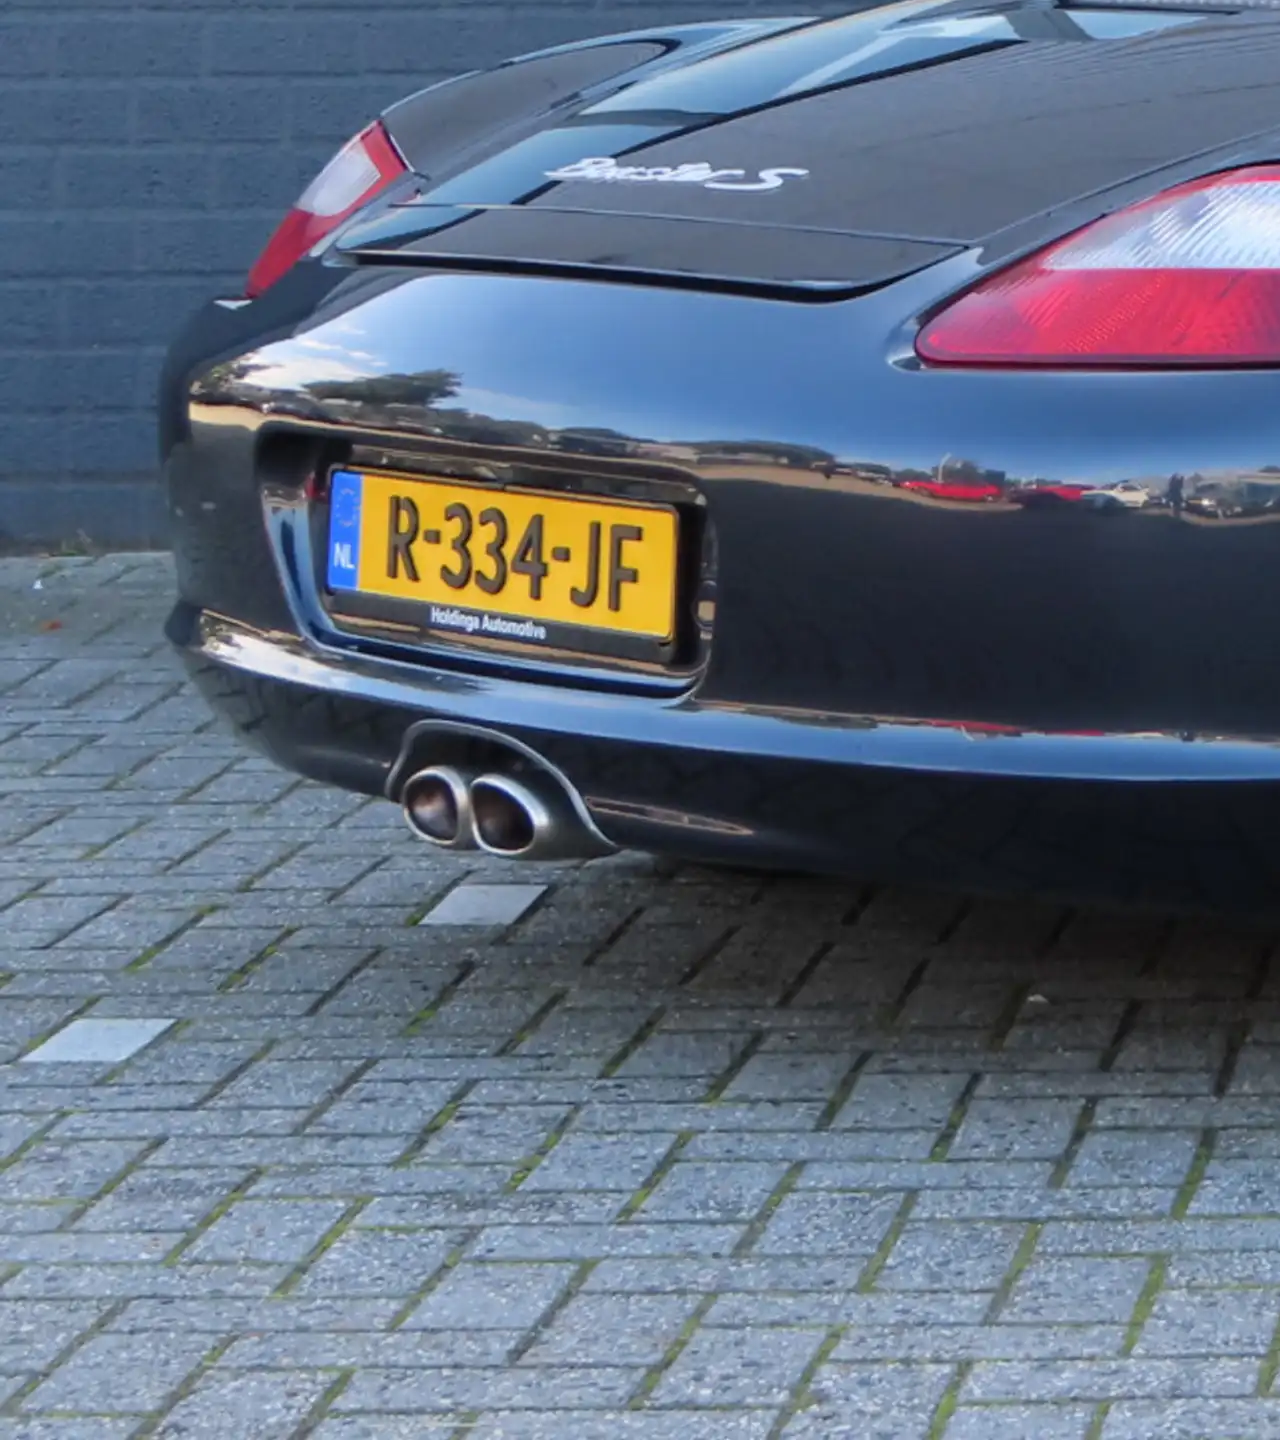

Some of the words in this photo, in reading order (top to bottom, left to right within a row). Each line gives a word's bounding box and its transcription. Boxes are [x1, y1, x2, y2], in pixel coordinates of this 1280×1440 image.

[703, 167, 809, 190] S
[333, 541, 357, 570] NL
[386, 495, 645, 611] R-334-JF
[481, 615, 548, 641] Automotive
